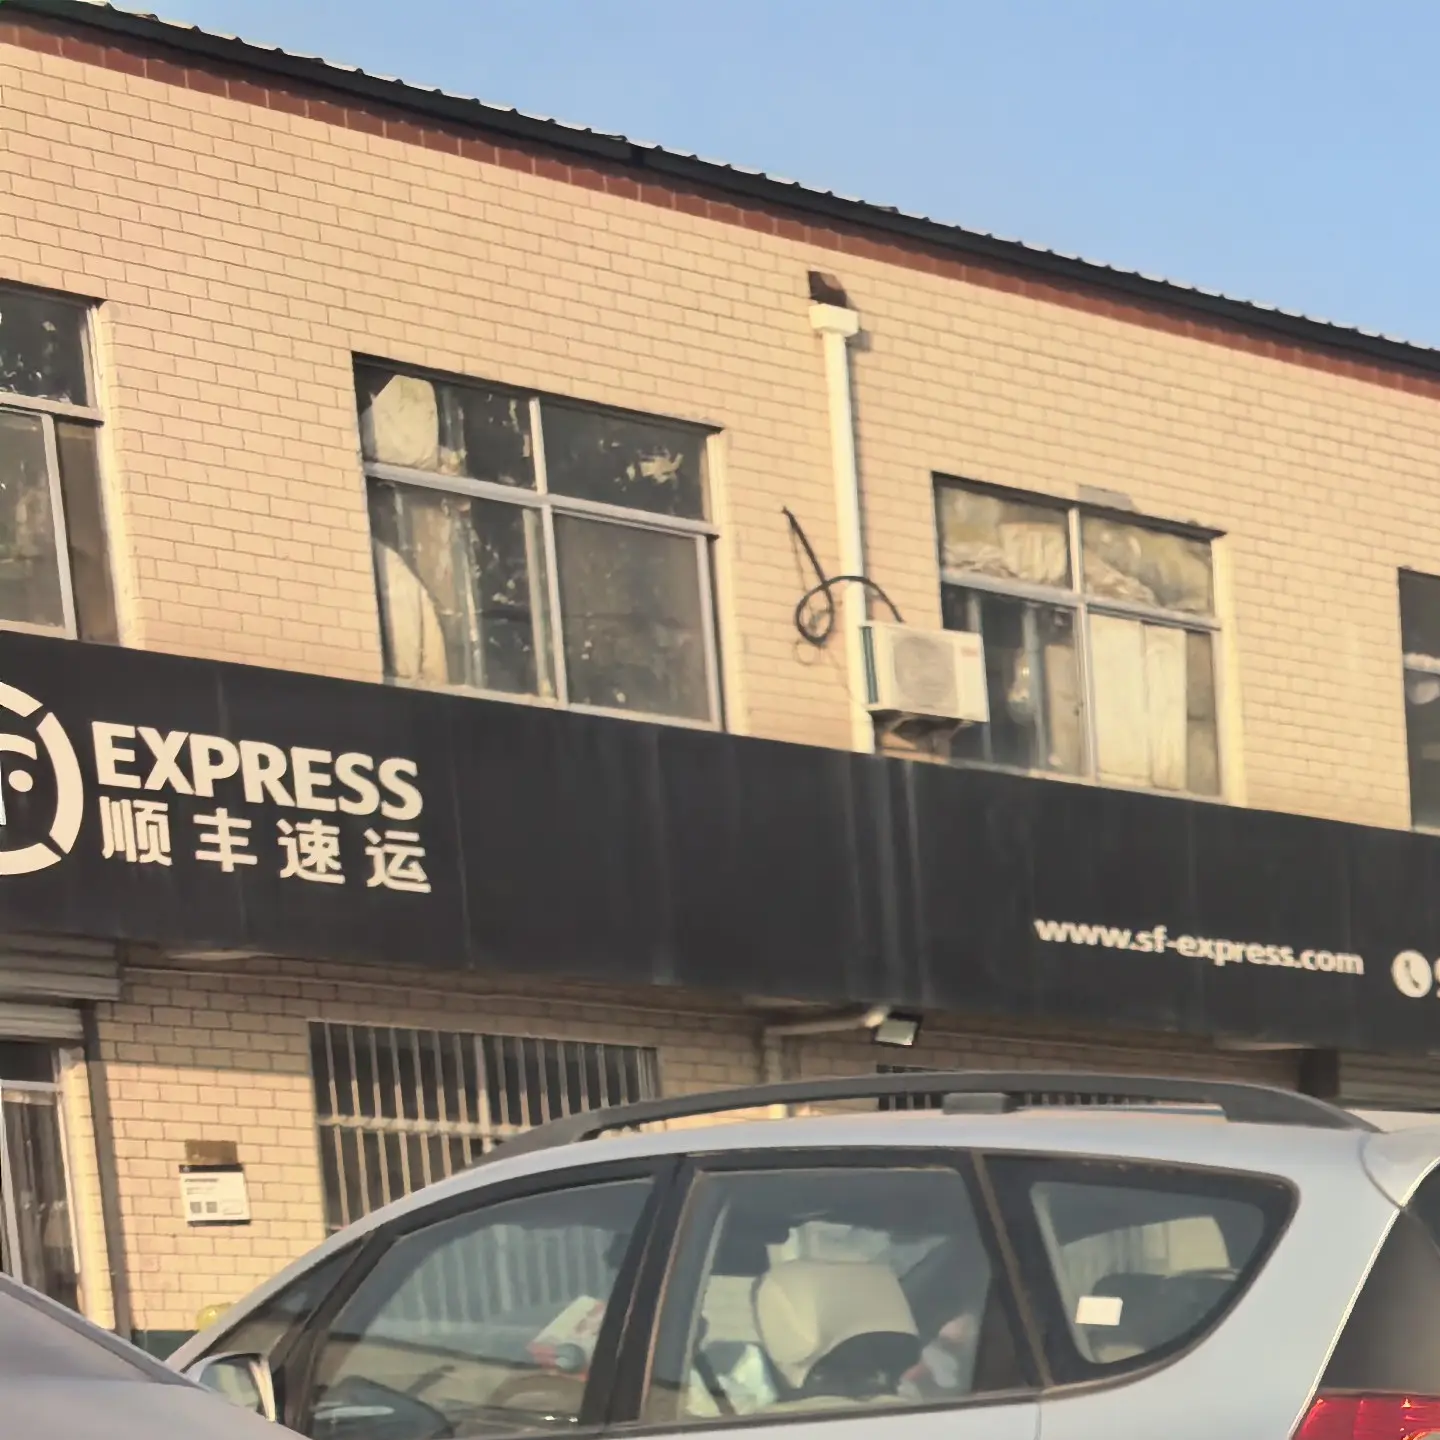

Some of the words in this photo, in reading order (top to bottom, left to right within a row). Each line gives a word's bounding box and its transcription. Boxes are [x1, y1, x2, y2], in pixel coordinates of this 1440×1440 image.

[92, 721, 423, 820] EXPRESS
[99, 796, 432, 893] 顺丰速运
[1033, 918, 1365, 977] www.sf-express.com
